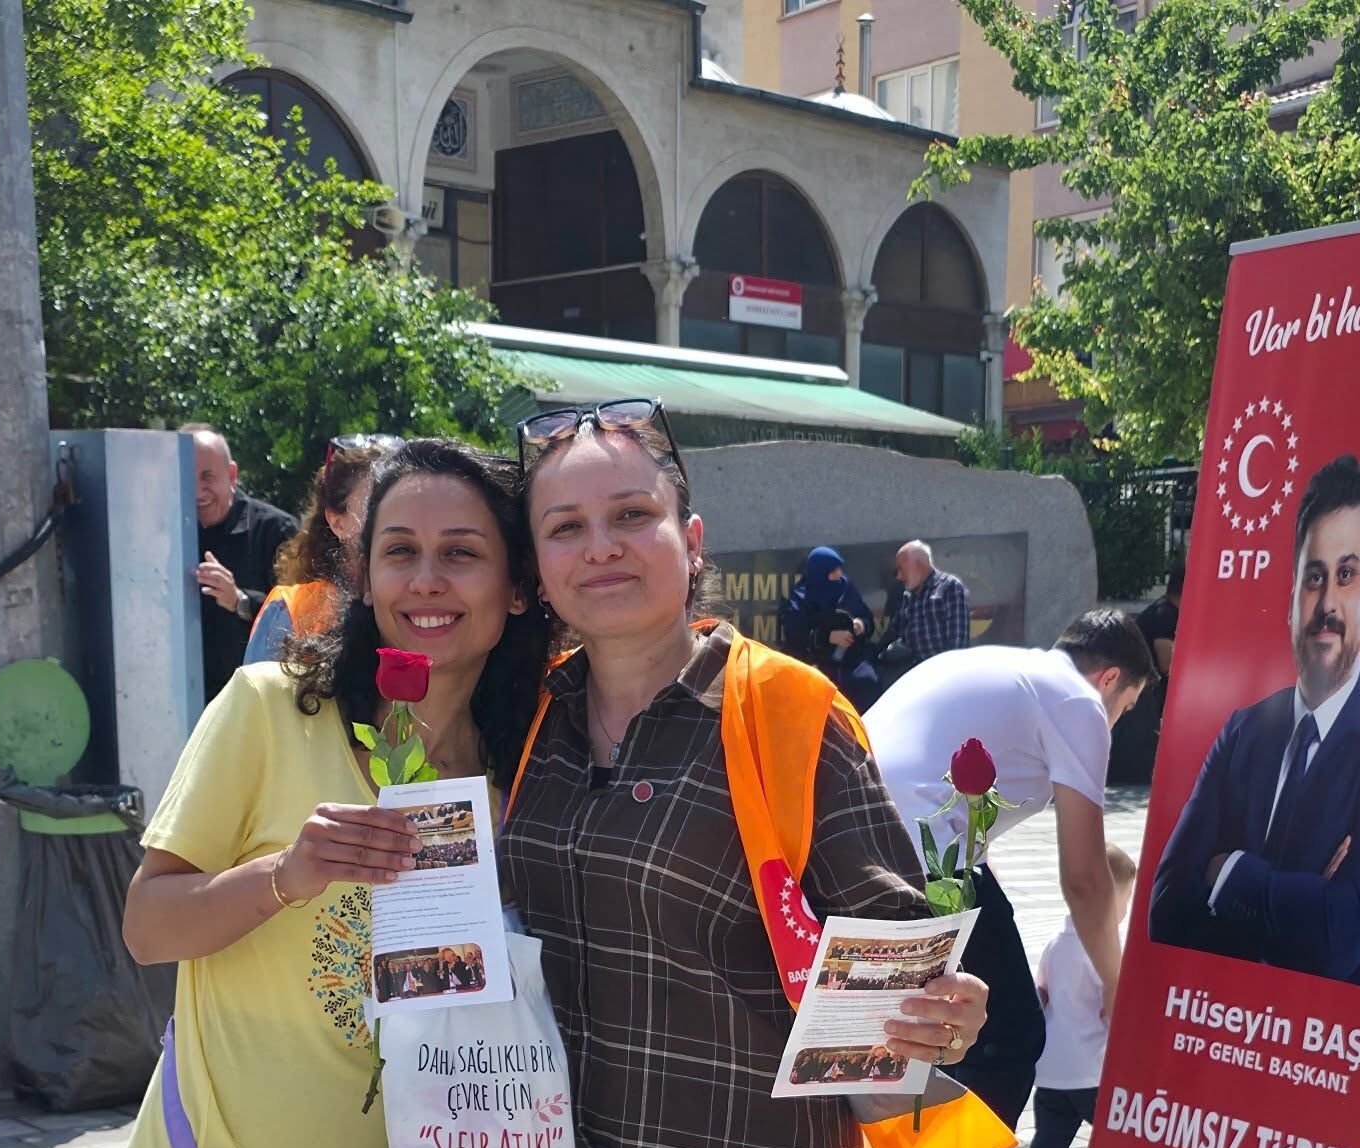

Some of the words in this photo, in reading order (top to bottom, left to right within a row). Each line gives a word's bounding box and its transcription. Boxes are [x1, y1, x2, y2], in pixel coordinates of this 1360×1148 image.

[1245, 307, 1300, 356] Var
[1306, 293, 1335, 342] bi
[1218, 549, 1271, 580] BTP
[1164, 986, 1291, 1046] Hüseyin
[457, 1040, 527, 1074] SAĞLIKLI
[531, 1040, 556, 1072] BİR
[1173, 1033, 1205, 1055] BTP
[1209, 1041, 1264, 1073] GENEL
[1269, 1055, 1349, 1095] BAŞKANI
[448, 1081, 490, 1120] ÇEVRE
[495, 1078, 532, 1120] İÇİN
